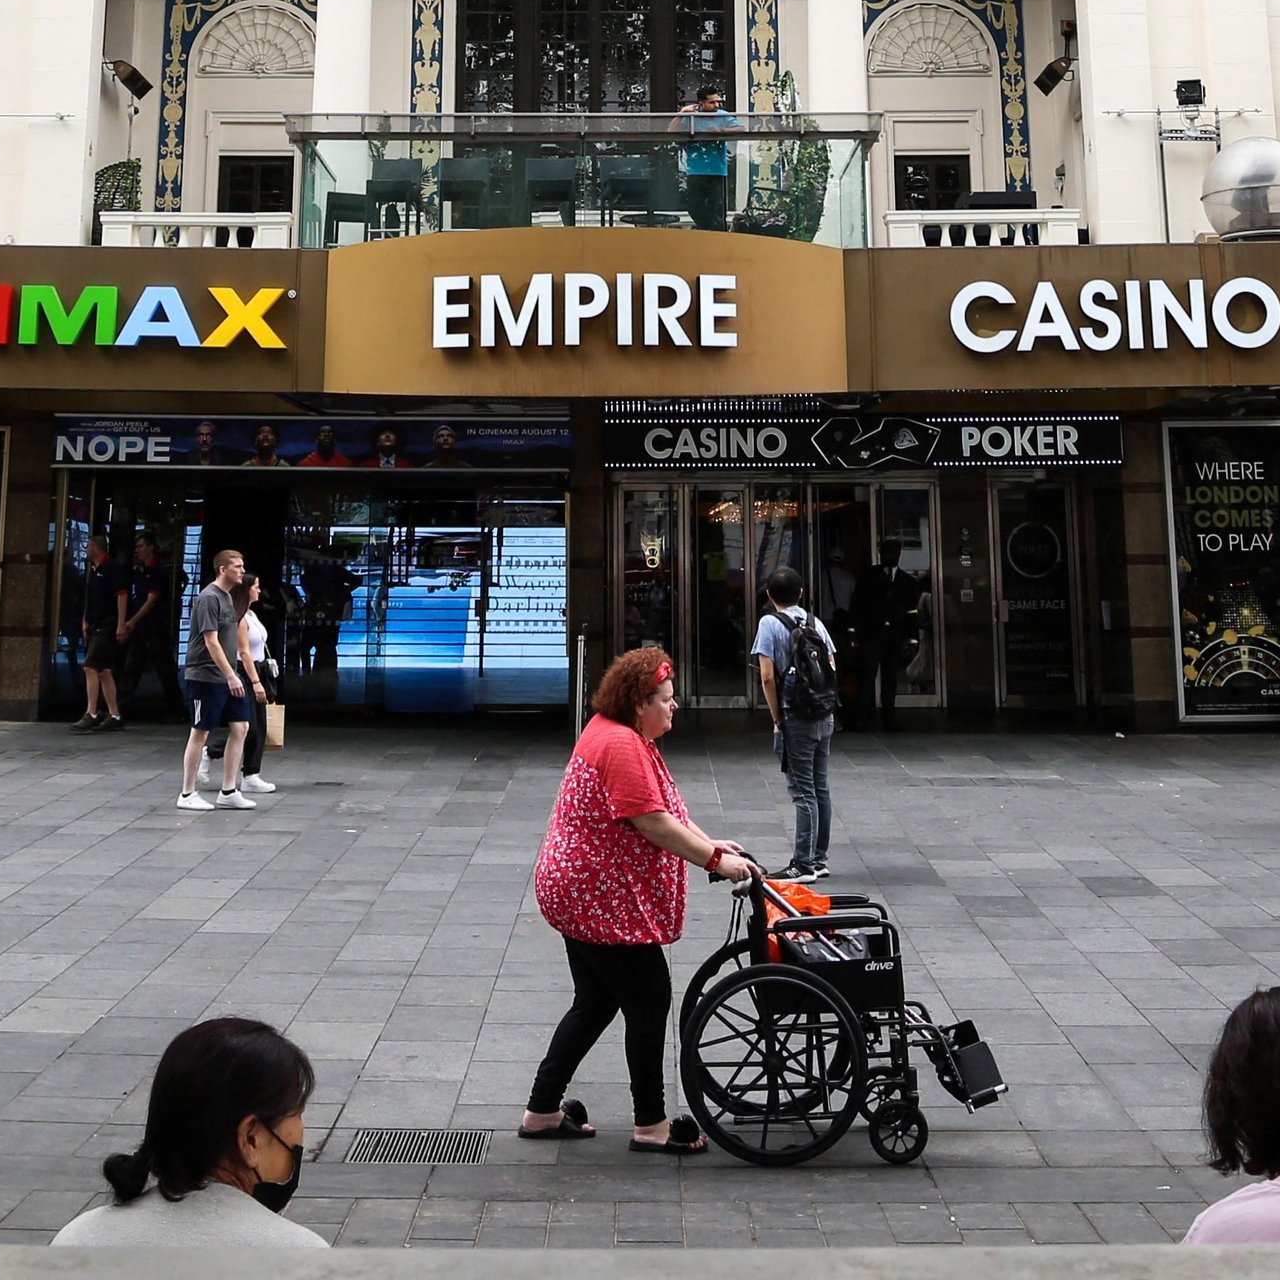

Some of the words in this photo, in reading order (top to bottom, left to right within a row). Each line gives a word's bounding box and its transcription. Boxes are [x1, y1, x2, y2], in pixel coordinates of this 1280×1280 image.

[432, 272, 738, 349] EMPIRE
[478, 428, 519, 436] CINEMAS
[521, 428, 558, 436] AUGUST
[559, 428, 569, 436] 12
[961, 424, 1080, 457] POKER
[55, 435, 171, 462] NOPE
[644, 426, 788, 459] CASINO
[1195, 461, 1265, 481] WHERE
[1185, 485, 1279, 505] LONDON
[1194, 509, 1274, 528] COMES
[1197, 533, 1223, 552] TO
[1228, 533, 1273, 552] PLAY
[1008, 599, 1038, 610] GAME
[1040, 599, 1066, 609] FACE
[864, 960, 894, 971] drive
